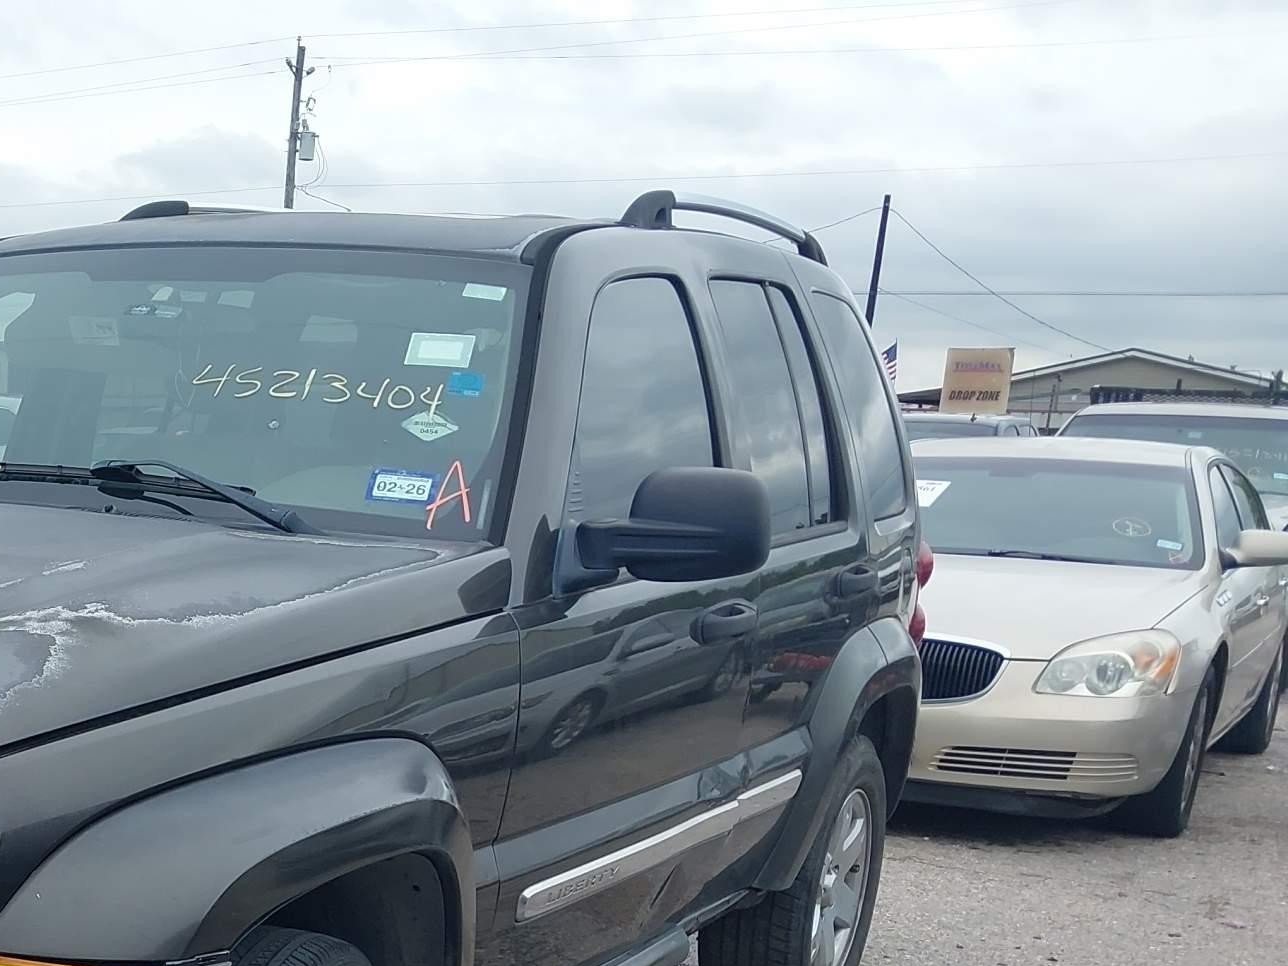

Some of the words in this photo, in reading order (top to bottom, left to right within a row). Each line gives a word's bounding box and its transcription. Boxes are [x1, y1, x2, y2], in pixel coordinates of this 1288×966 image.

[192, 363, 445, 418] 45213404
[948, 390, 975, 401] DROP
[976, 390, 1001, 401] ZONE
[426, 460, 471, 530] A
[546, 864, 621, 902] LIBERTY
